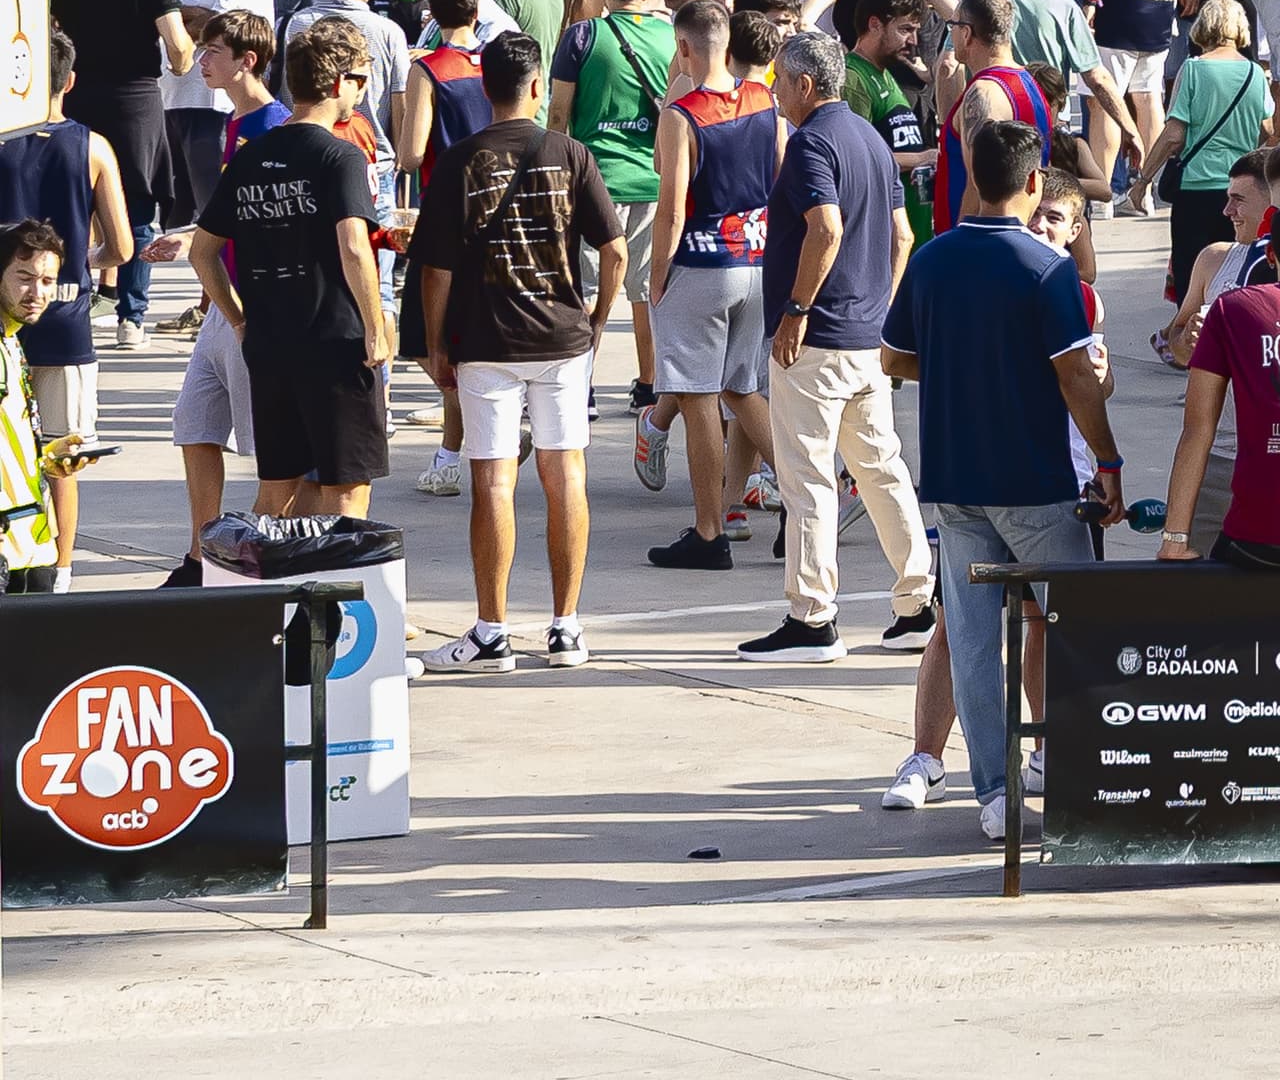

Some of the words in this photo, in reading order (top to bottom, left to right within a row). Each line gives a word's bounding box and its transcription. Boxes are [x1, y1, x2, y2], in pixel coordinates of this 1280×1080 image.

[272, 180, 312, 200] MUSIC
[262, 200, 296, 219] SAVE
[297, 196, 318, 214] US
[1146, 645, 1172, 660] City
[1174, 644, 1188, 658] of
[1146, 658, 1239, 675] BADALONA
[77, 684, 174, 750] FAN
[1137, 704, 1207, 721] GWM
[1100, 749, 1151, 765] Wilson
[1174, 748, 1229, 759] azulmarino
[40, 746, 220, 799] zone
[1098, 788, 1141, 801] Transaher
[102, 808, 149, 830] acb
